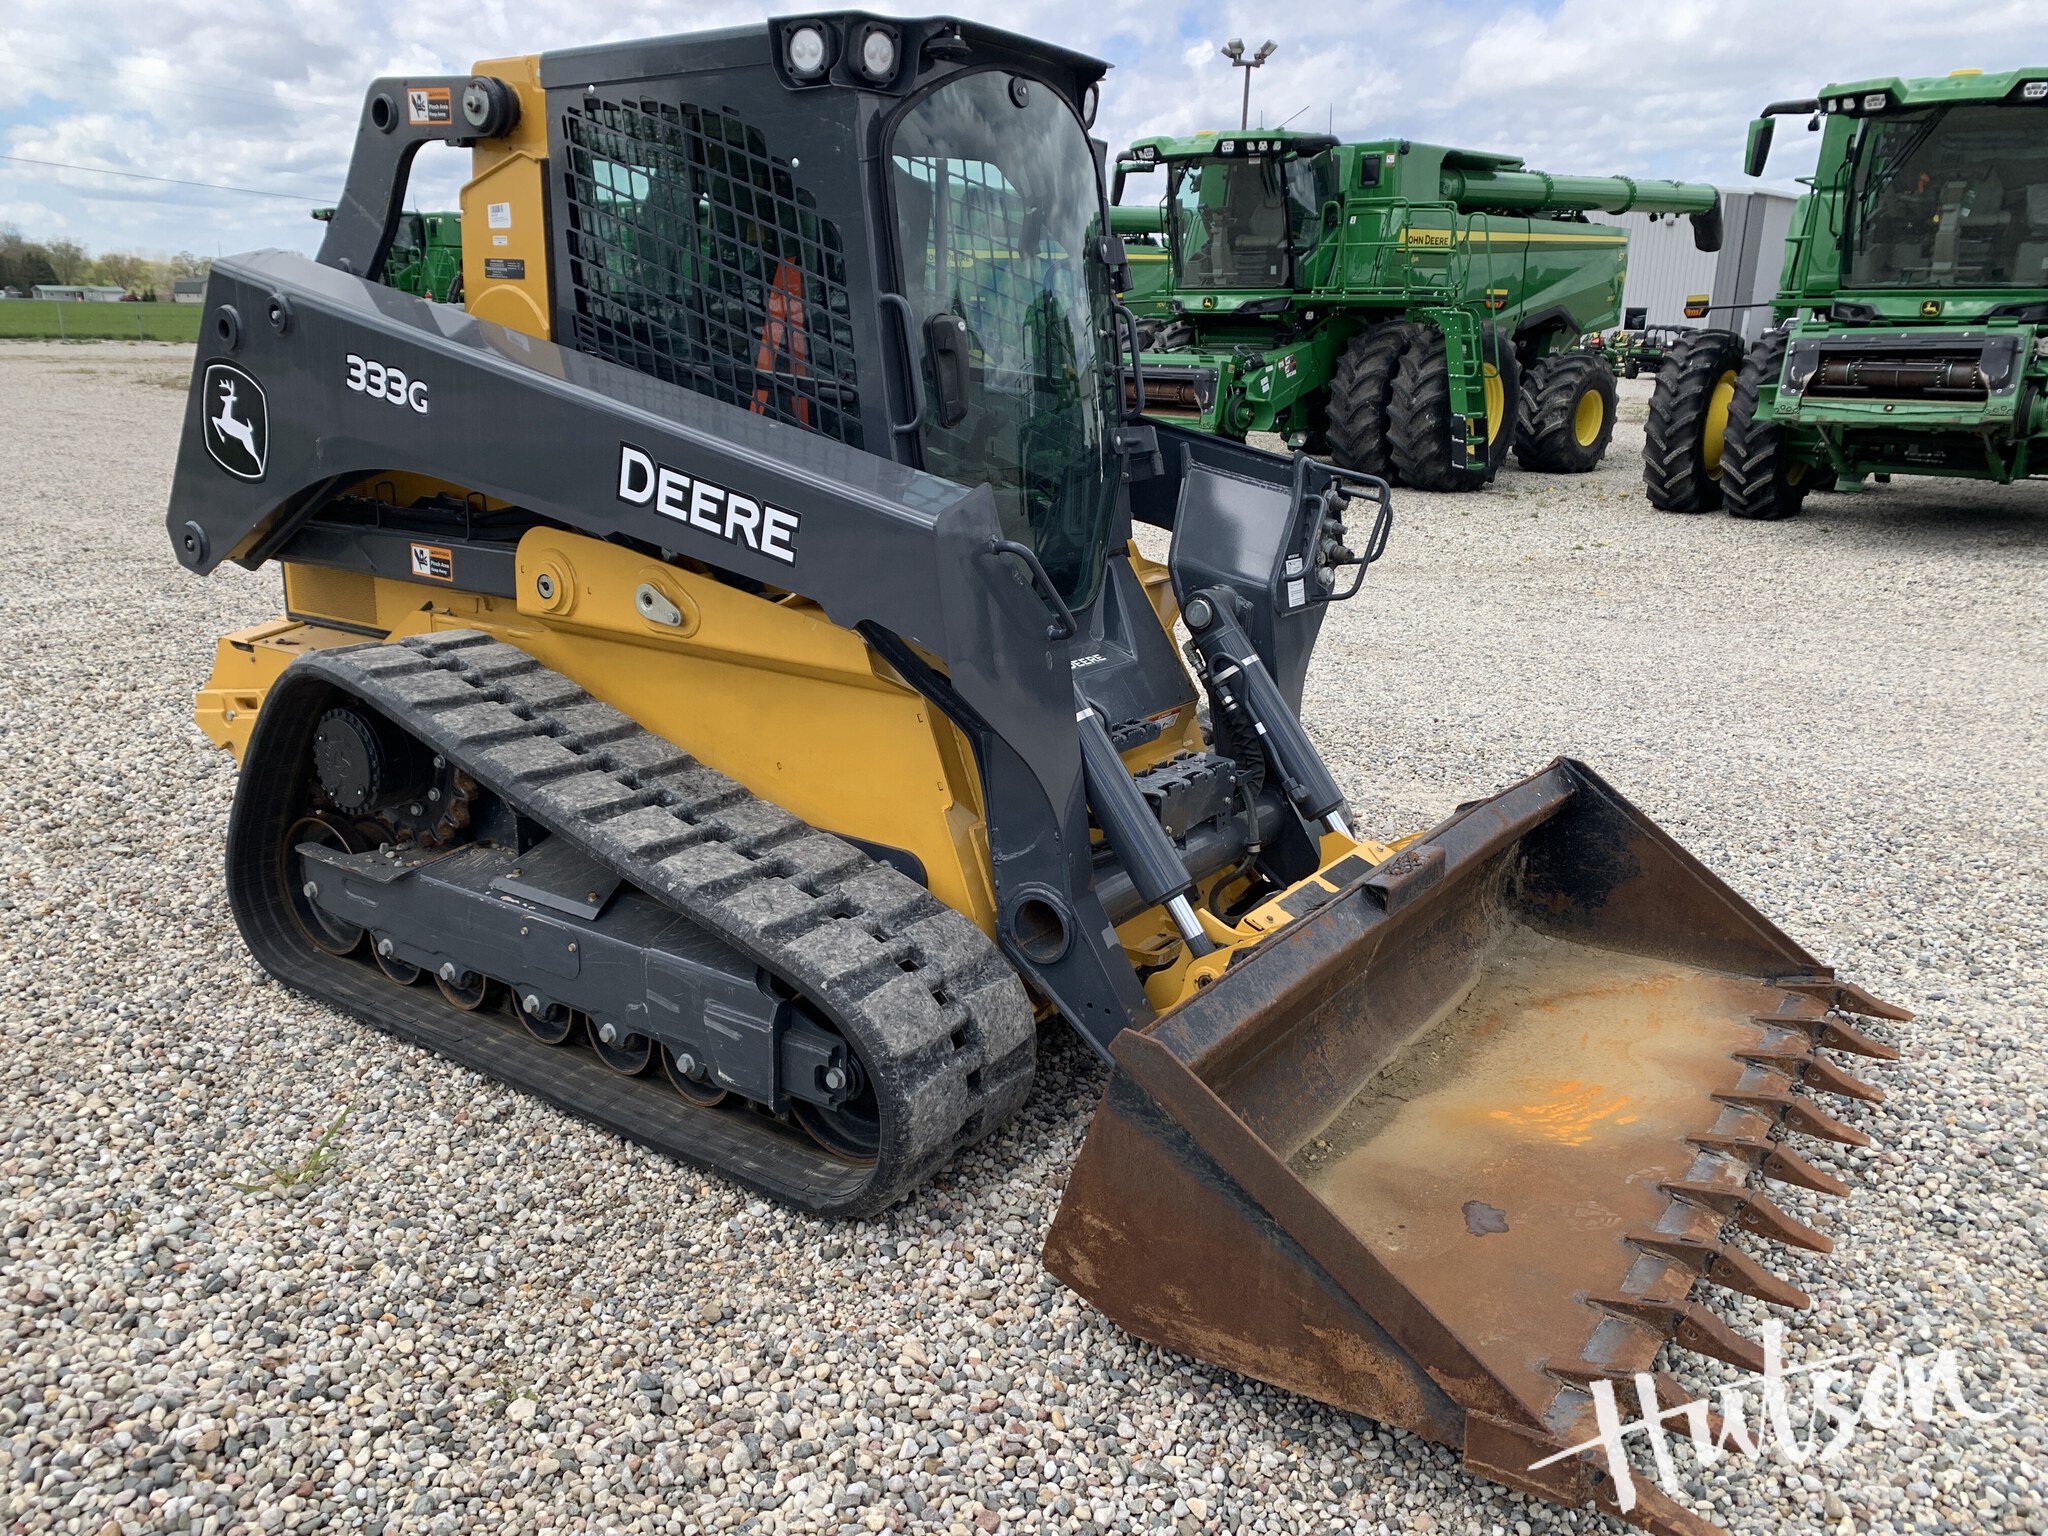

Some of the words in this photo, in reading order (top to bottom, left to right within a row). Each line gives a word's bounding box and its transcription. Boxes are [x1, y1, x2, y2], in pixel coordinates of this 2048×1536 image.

[1406, 235, 1424, 245] OHN
[346, 354, 428, 413] 333G
[619, 446, 799, 563] DEERE
